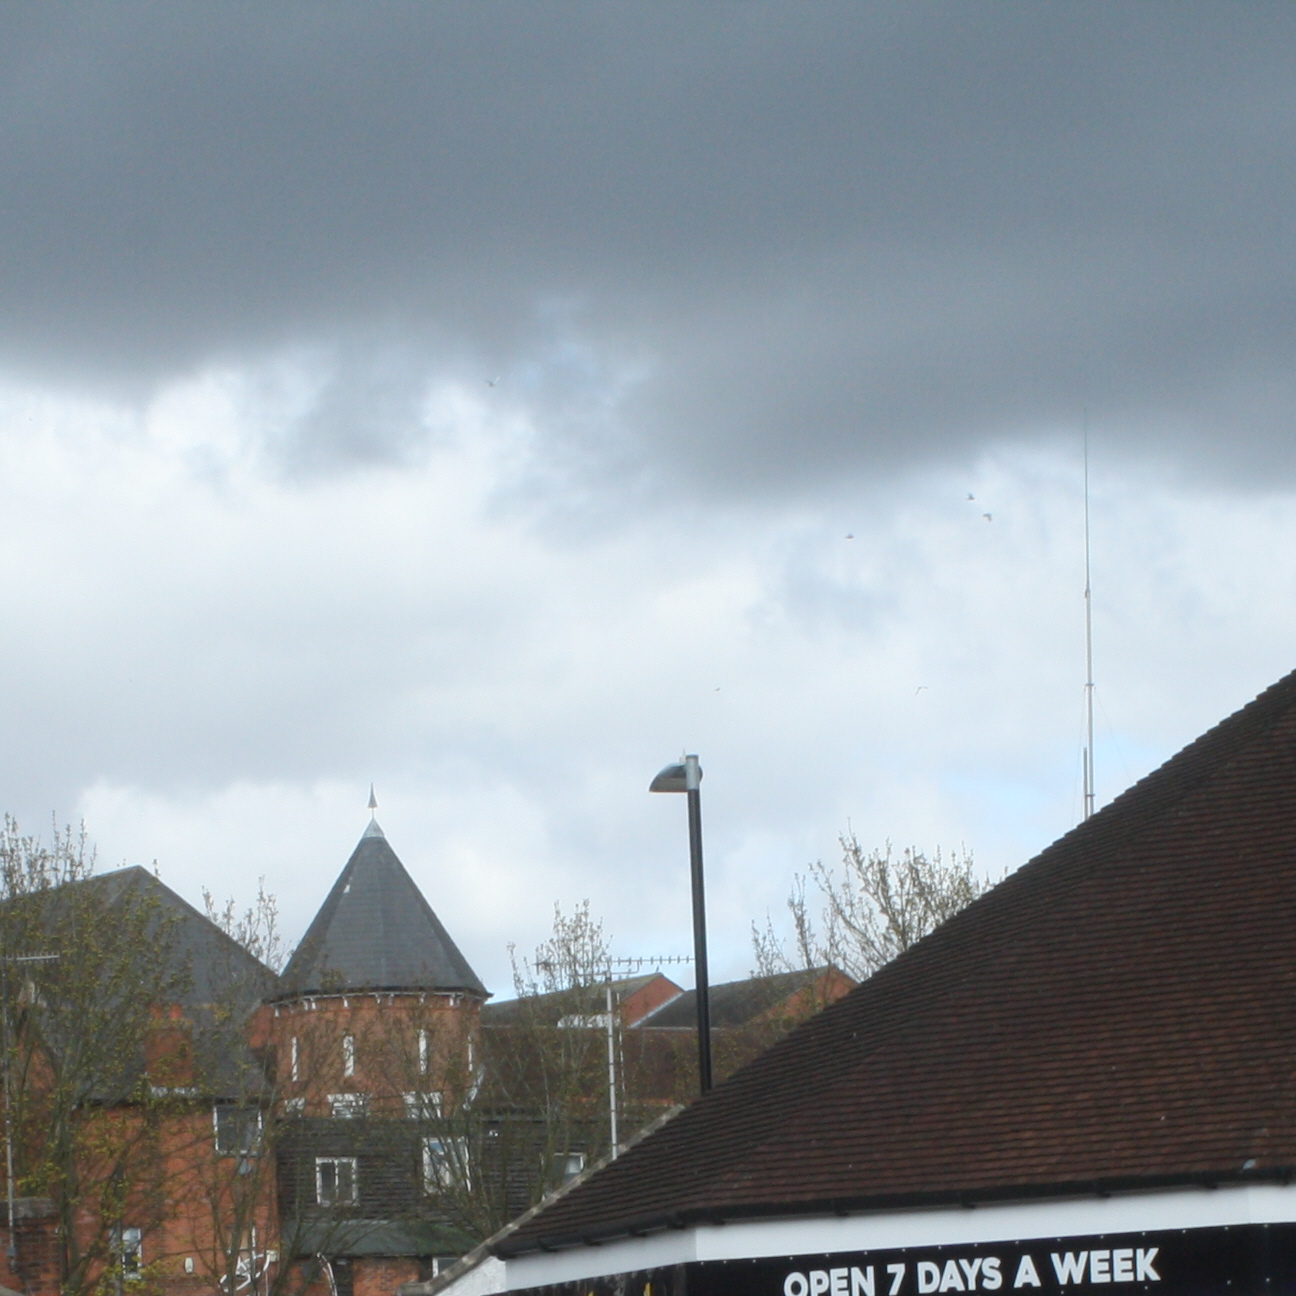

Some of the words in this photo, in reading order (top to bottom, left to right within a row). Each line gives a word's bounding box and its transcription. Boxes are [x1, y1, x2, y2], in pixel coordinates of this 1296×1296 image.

[887, 1264, 906, 1296] 7
[917, 1257, 1002, 1293] DAYS
[1013, 1254, 1041, 1287] A
[1051, 1247, 1161, 1285] WEEK
